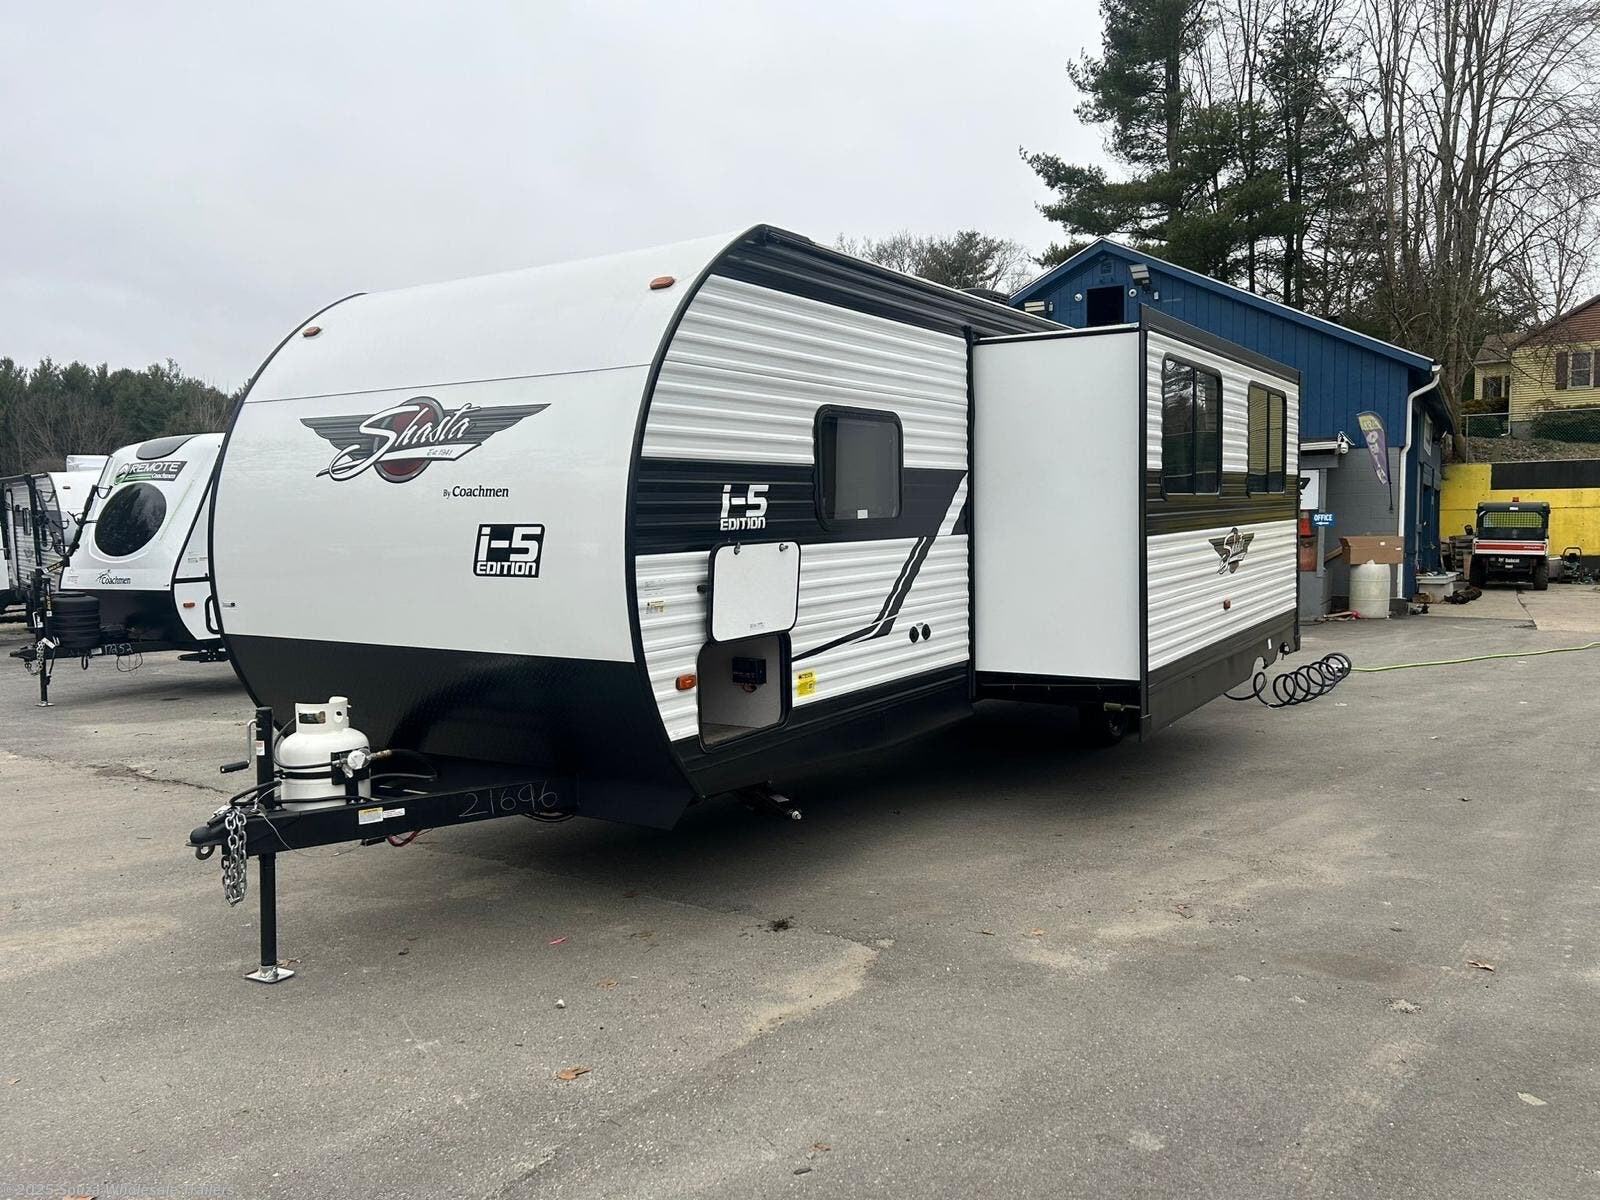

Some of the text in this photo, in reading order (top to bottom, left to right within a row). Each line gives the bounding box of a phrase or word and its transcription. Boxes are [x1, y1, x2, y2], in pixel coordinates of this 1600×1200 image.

[328, 403, 481, 481] Shasta
[130, 462, 181, 473] REMOTE
[443, 485, 510, 498] By Coachmen
[720, 484, 769, 518] i-5
[720, 517, 766, 531] EDITION
[477, 526, 542, 562] i-5
[476, 561, 537, 575] EDITION
[101, 576, 131, 585] Coachmen
[458, 780, 558, 817] 21696
